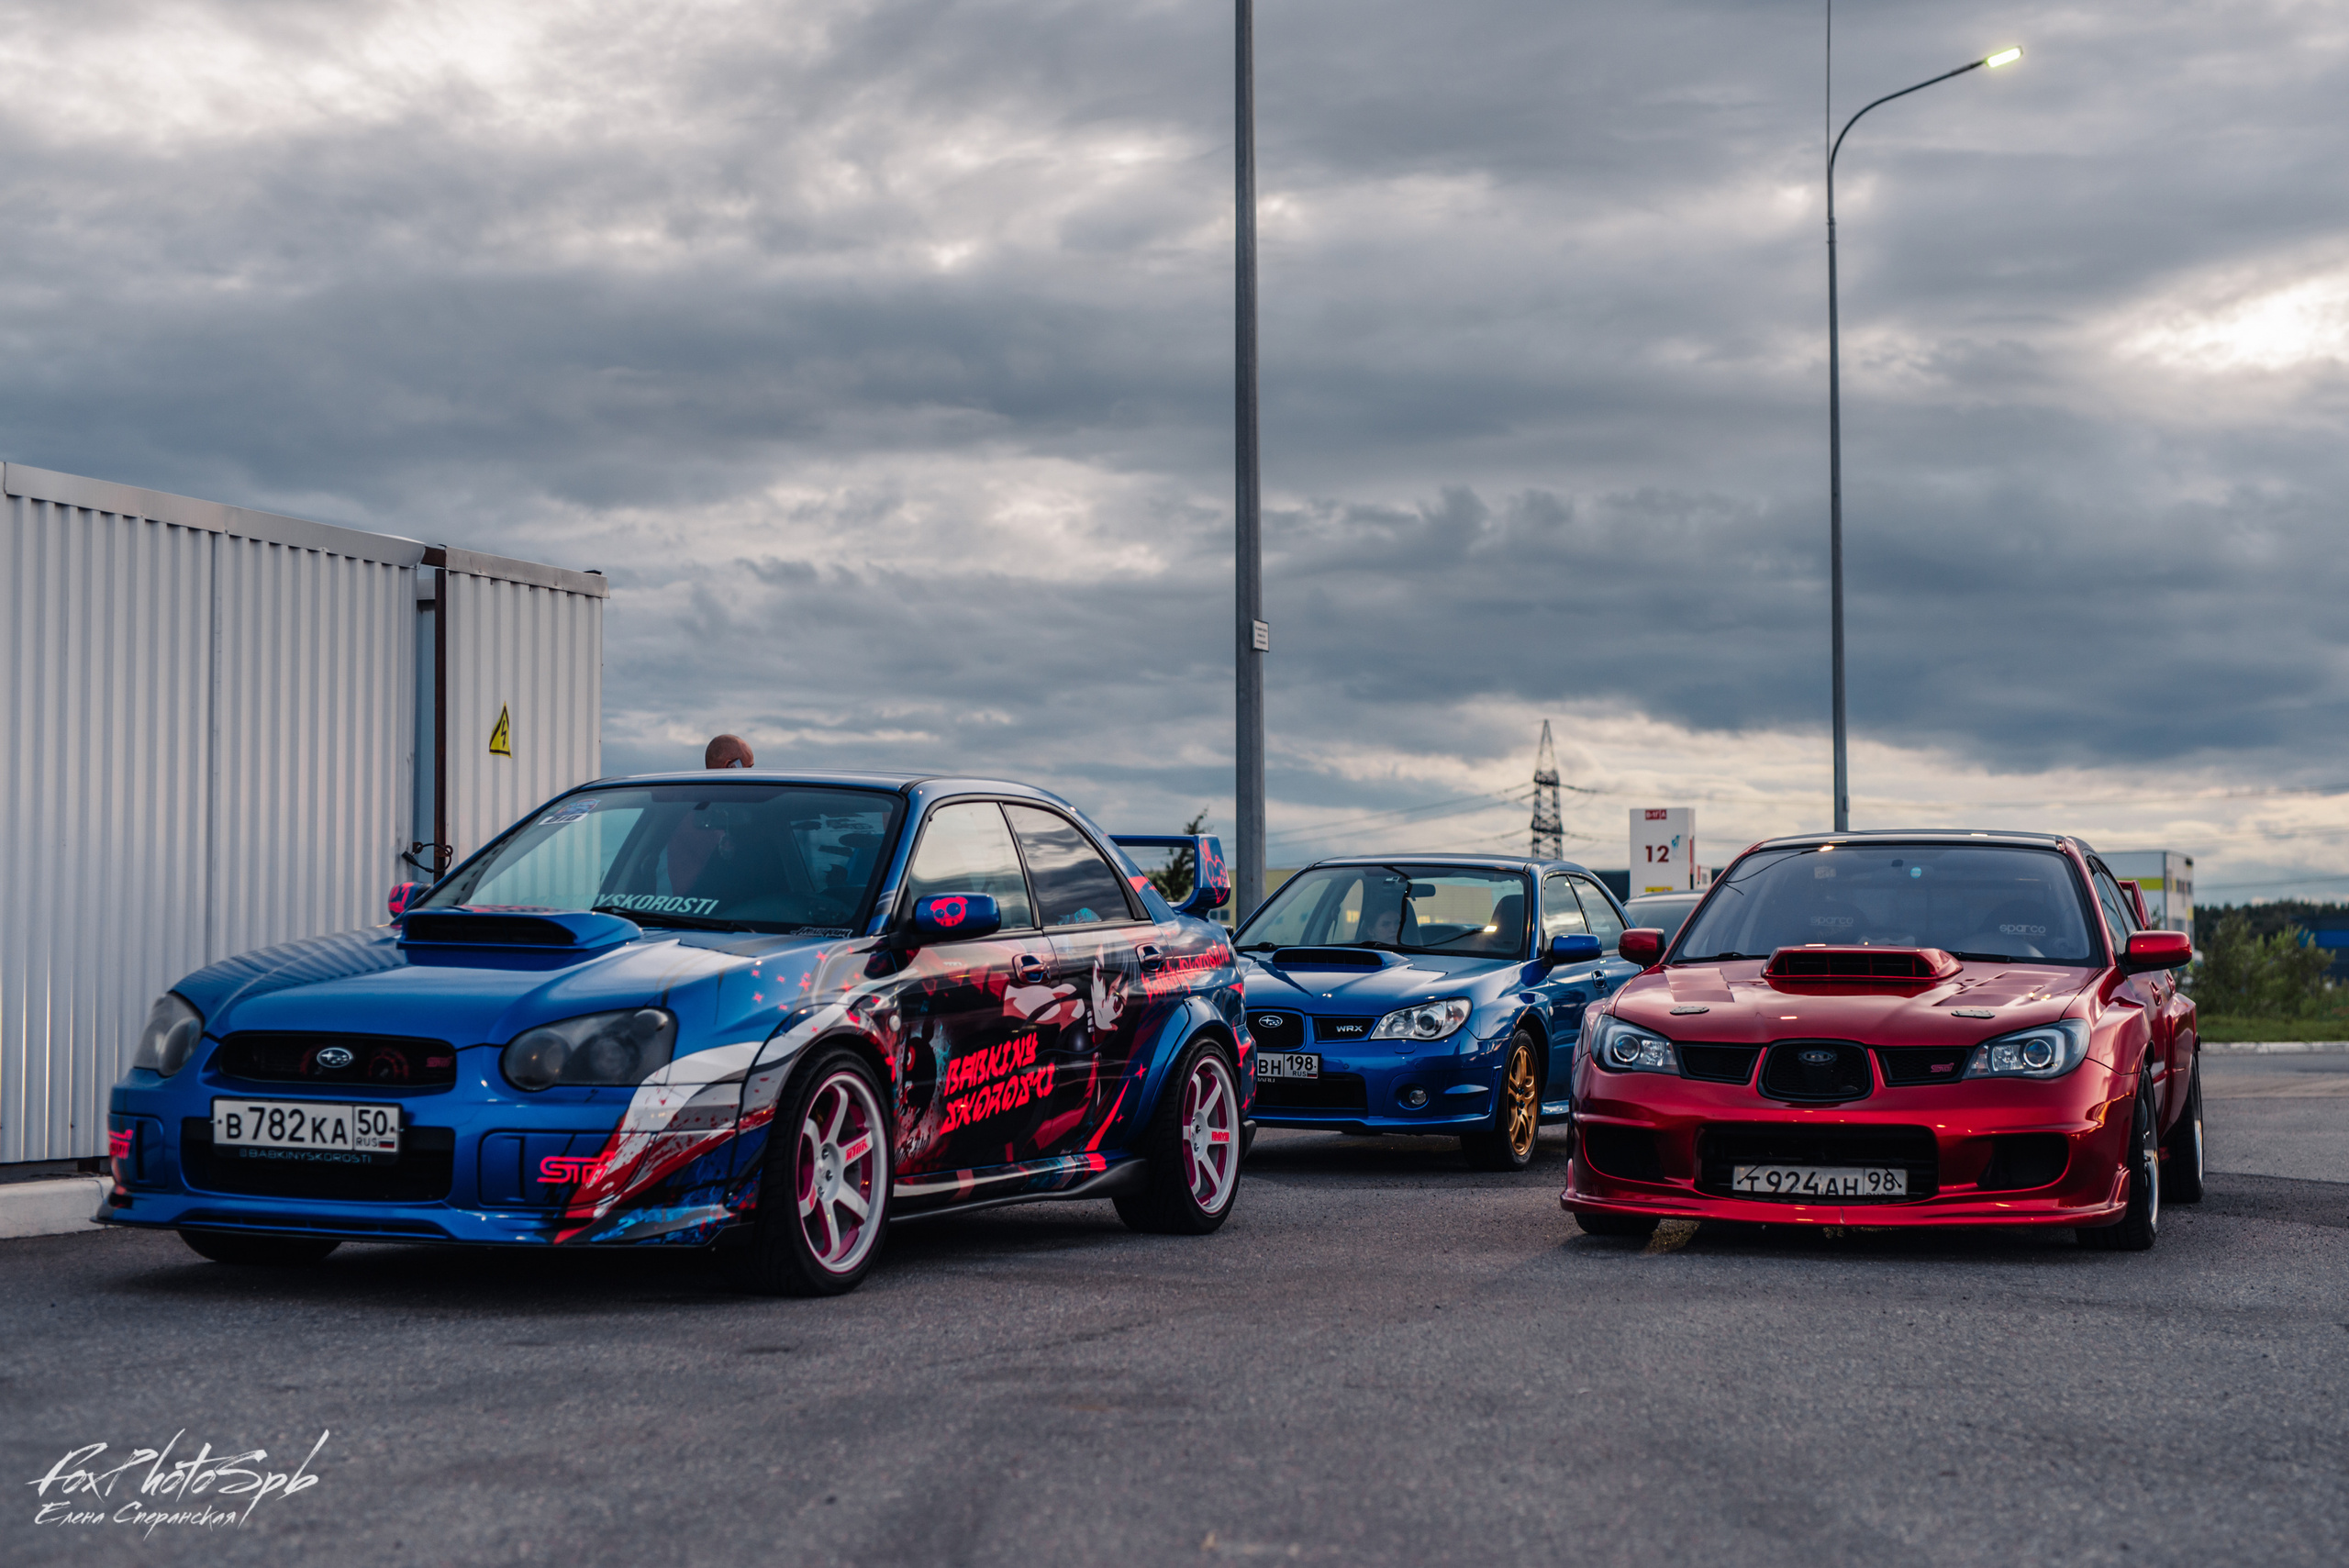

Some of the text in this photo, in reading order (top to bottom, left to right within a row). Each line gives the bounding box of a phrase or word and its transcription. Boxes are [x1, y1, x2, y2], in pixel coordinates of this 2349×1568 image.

[1645, 844, 1669, 862] 12
[1810, 917, 1854, 927] sparco
[1999, 924, 2046, 935] sparco
[943, 1031, 1039, 1097] BABKINY
[1286, 1055, 1314, 1071] 198
[357, 1109, 387, 1136] 50
[355, 1137, 378, 1147] RUS
[1867, 1172, 1896, 1192] 98
